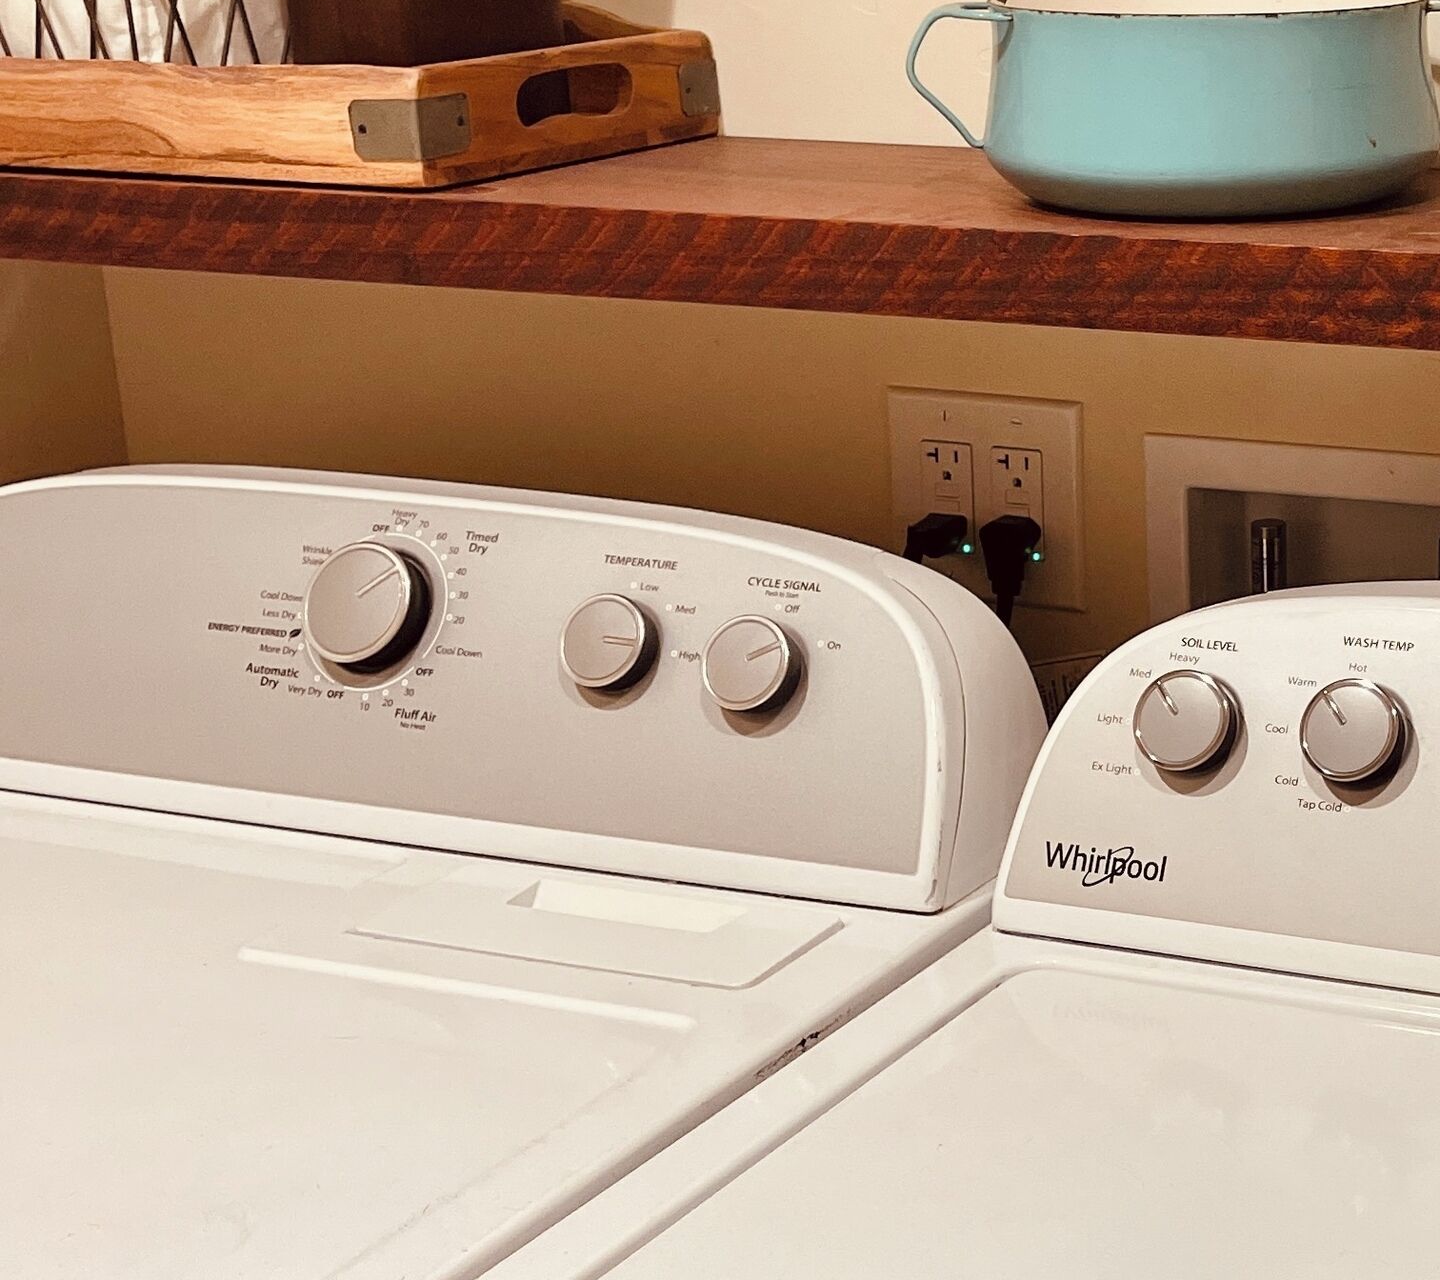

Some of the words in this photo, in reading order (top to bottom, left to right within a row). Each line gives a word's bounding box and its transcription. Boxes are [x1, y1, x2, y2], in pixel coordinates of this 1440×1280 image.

[392, 509, 418, 520] Heavy
[394, 517, 410, 526] Dry
[419, 520, 430, 528] 70
[372, 524, 390, 532] OFF
[436, 532, 448, 540] 60
[466, 530, 500, 543] Timed
[448, 546, 460, 554] 50
[468, 542, 488, 555] Dry
[604, 554, 678, 571] TEMPERATURE
[455, 567, 467, 576] 40
[639, 582, 660, 593] Low
[747, 576, 780, 589] CYCLE
[783, 579, 822, 593] SIGNAL
[260, 590, 280, 601] Cool
[457, 591, 469, 600] 30
[262, 608, 279, 618] Less
[281, 610, 296, 620] Dry
[674, 604, 696, 615] Med
[784, 604, 800, 614] Off
[452, 615, 465, 625] 20
[207, 622, 240, 633] ENERGY
[241, 626, 287, 638] PREFERRED
[259, 643, 281, 654] More
[282, 645, 298, 656] Dry
[827, 640, 841, 651] On
[1181, 636, 1205, 650] SOIL
[1206, 638, 1239, 652] LEVEL
[1343, 636, 1379, 650] WASH
[1380, 639, 1415, 652] TEMP
[435, 645, 456, 656] Cool
[457, 647, 483, 658] Down
[678, 650, 700, 661] High
[1169, 651, 1201, 666] Heavy
[245, 662, 300, 678] Automatic
[415, 667, 434, 677] OFF
[1128, 667, 1152, 680] Med
[1348, 662, 1368, 674] Hot
[260, 675, 280, 689] Dry
[1287, 676, 1318, 689] Warm
[288, 684, 307, 696] Very
[307, 687, 323, 698] Dry
[327, 690, 345, 700] OFF
[403, 688, 415, 697] 30
[360, 702, 370, 711] 10
[381, 699, 394, 707] 20
[394, 708, 420, 720] Fluff
[420, 711, 437, 723] Air
[1096, 713, 1124, 726] Light
[1264, 723, 1289, 735] Cool
[1091, 761, 1104, 773] Ex
[1105, 763, 1133, 777] Light
[1275, 775, 1299, 787] Cold
[1297, 798, 1317, 814] Tap
[1318, 800, 1343, 813] Cold
[1045, 840, 1168, 888] Whirlpool
